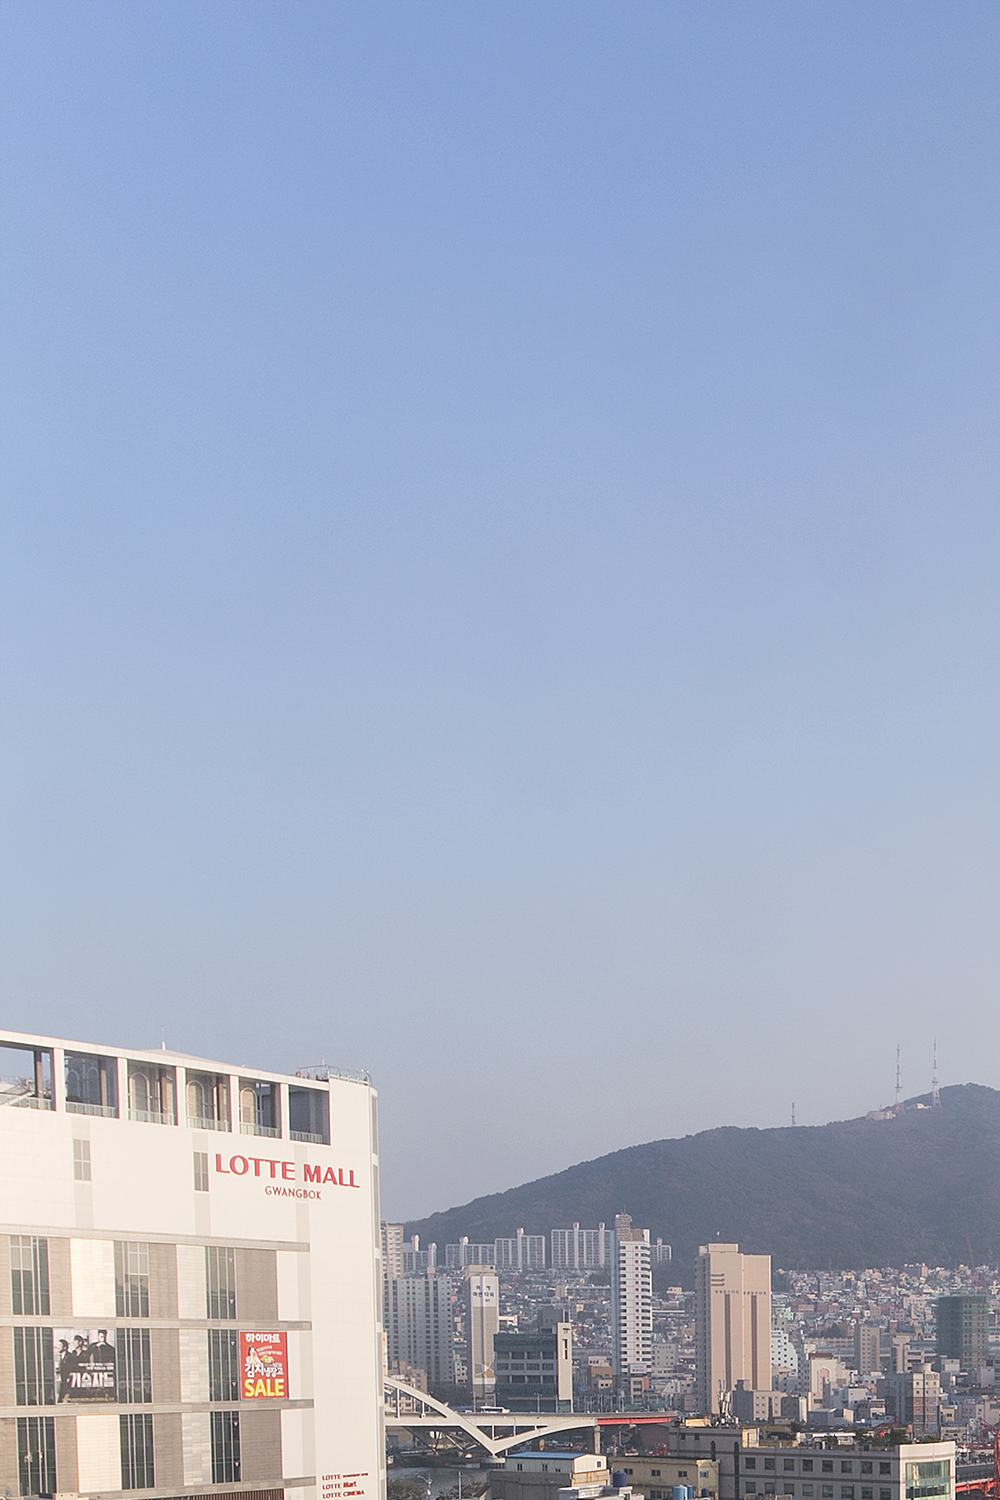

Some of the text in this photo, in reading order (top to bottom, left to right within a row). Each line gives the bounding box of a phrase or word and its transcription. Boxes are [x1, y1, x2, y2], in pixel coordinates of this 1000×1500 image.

[215, 1153, 360, 1189] LOTTE MALL
[264, 1185, 322, 1200] GWANGBOK
[245, 1333, 281, 1344] 하이마트
[244, 1362, 284, 1378] 김치냉장고
[244, 1378, 285, 1397] SALE
